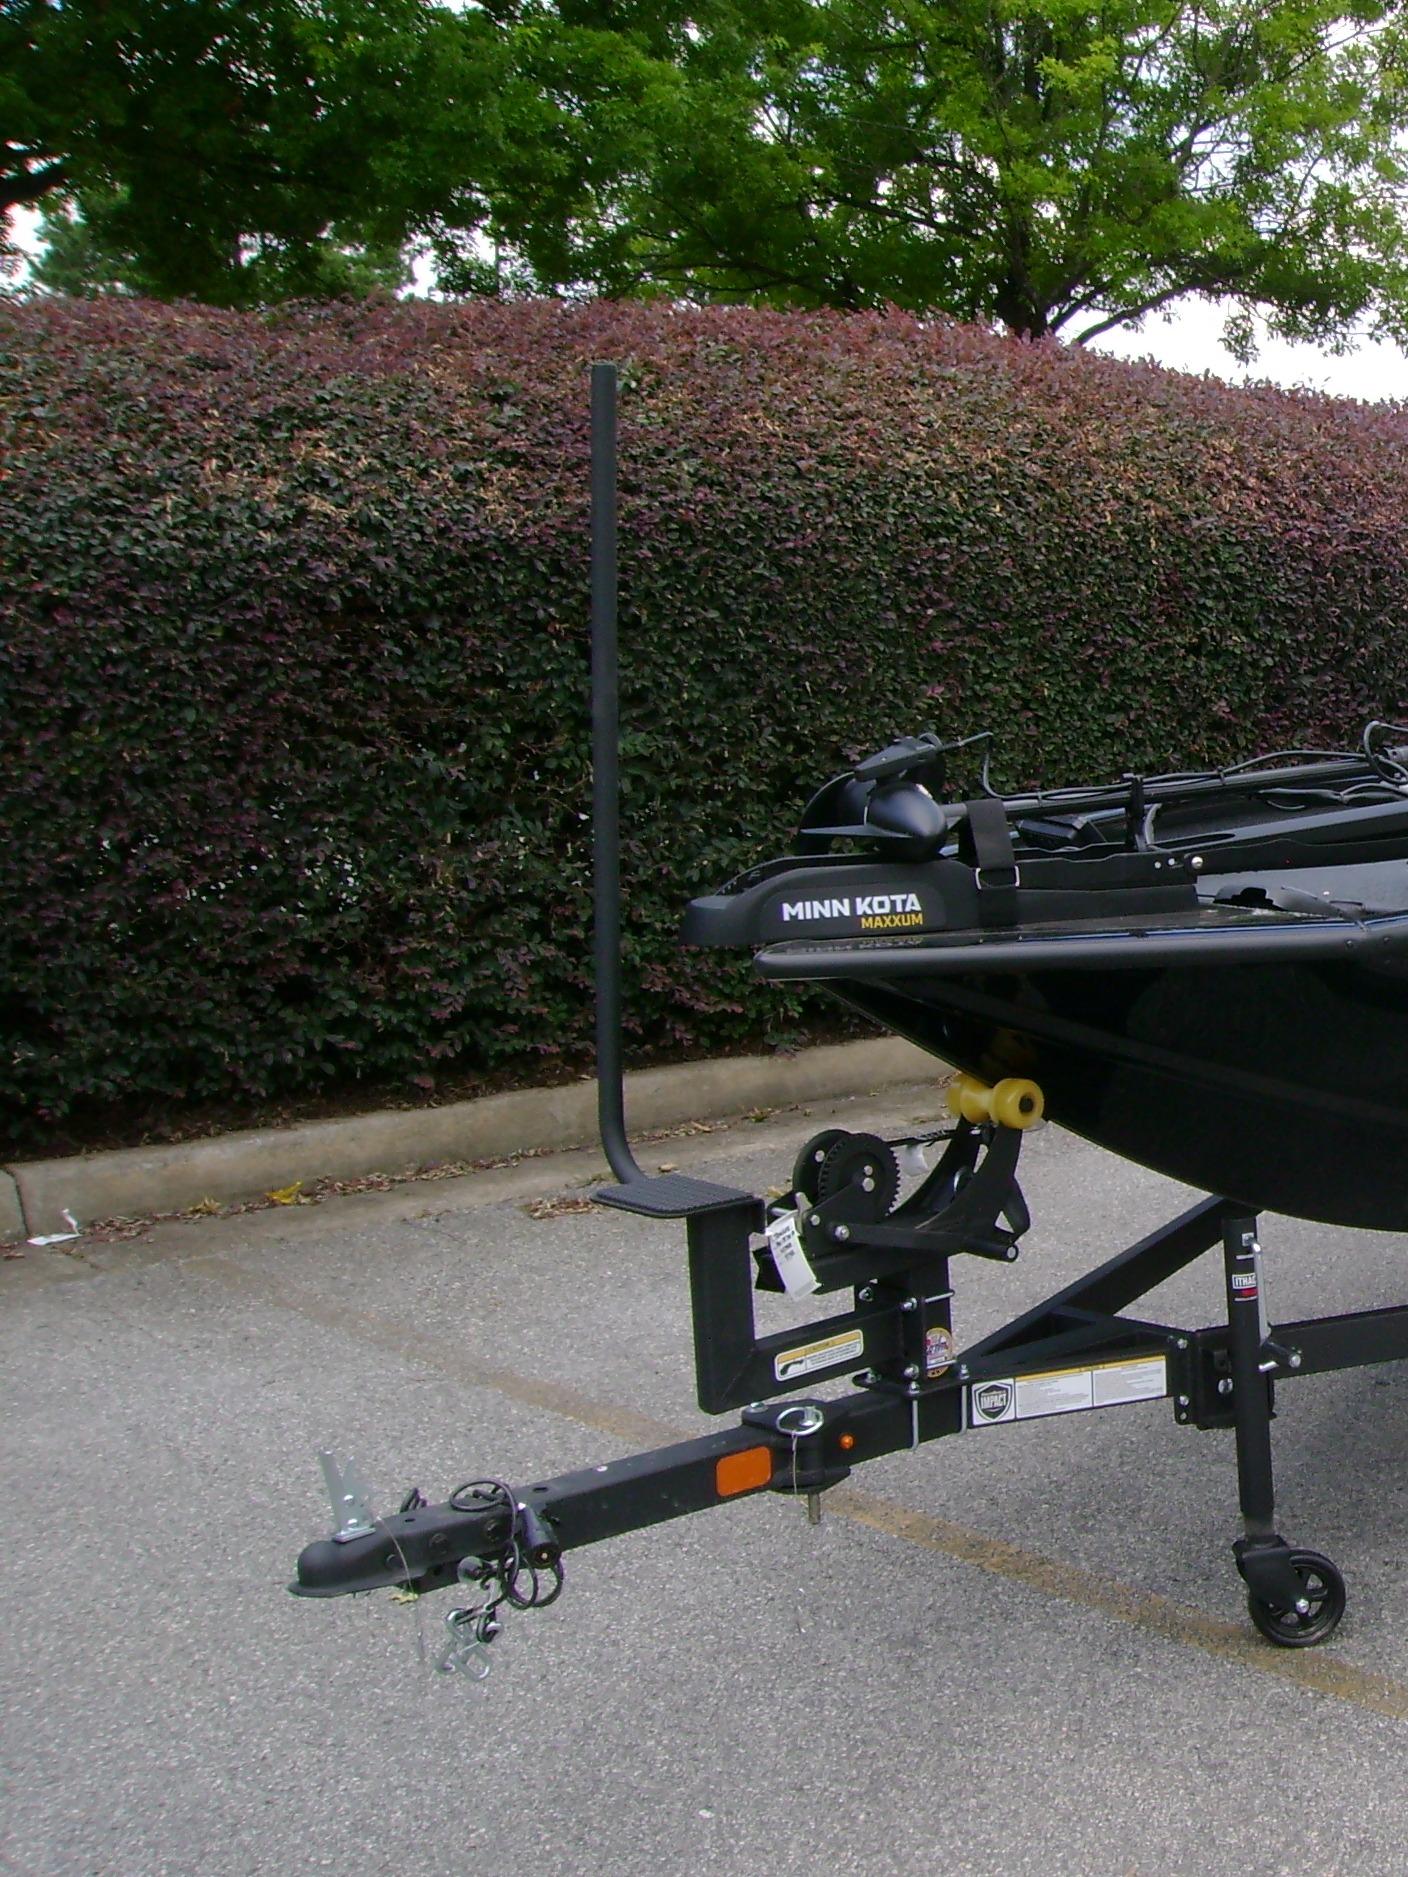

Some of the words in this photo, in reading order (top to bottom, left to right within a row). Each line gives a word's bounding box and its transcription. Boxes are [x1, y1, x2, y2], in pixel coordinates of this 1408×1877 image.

[782, 898, 851, 922] MINN
[855, 893, 922, 916] KOTA
[861, 913, 924, 929] MAXXUM
[980, 1392, 1007, 1410] IMPACT
